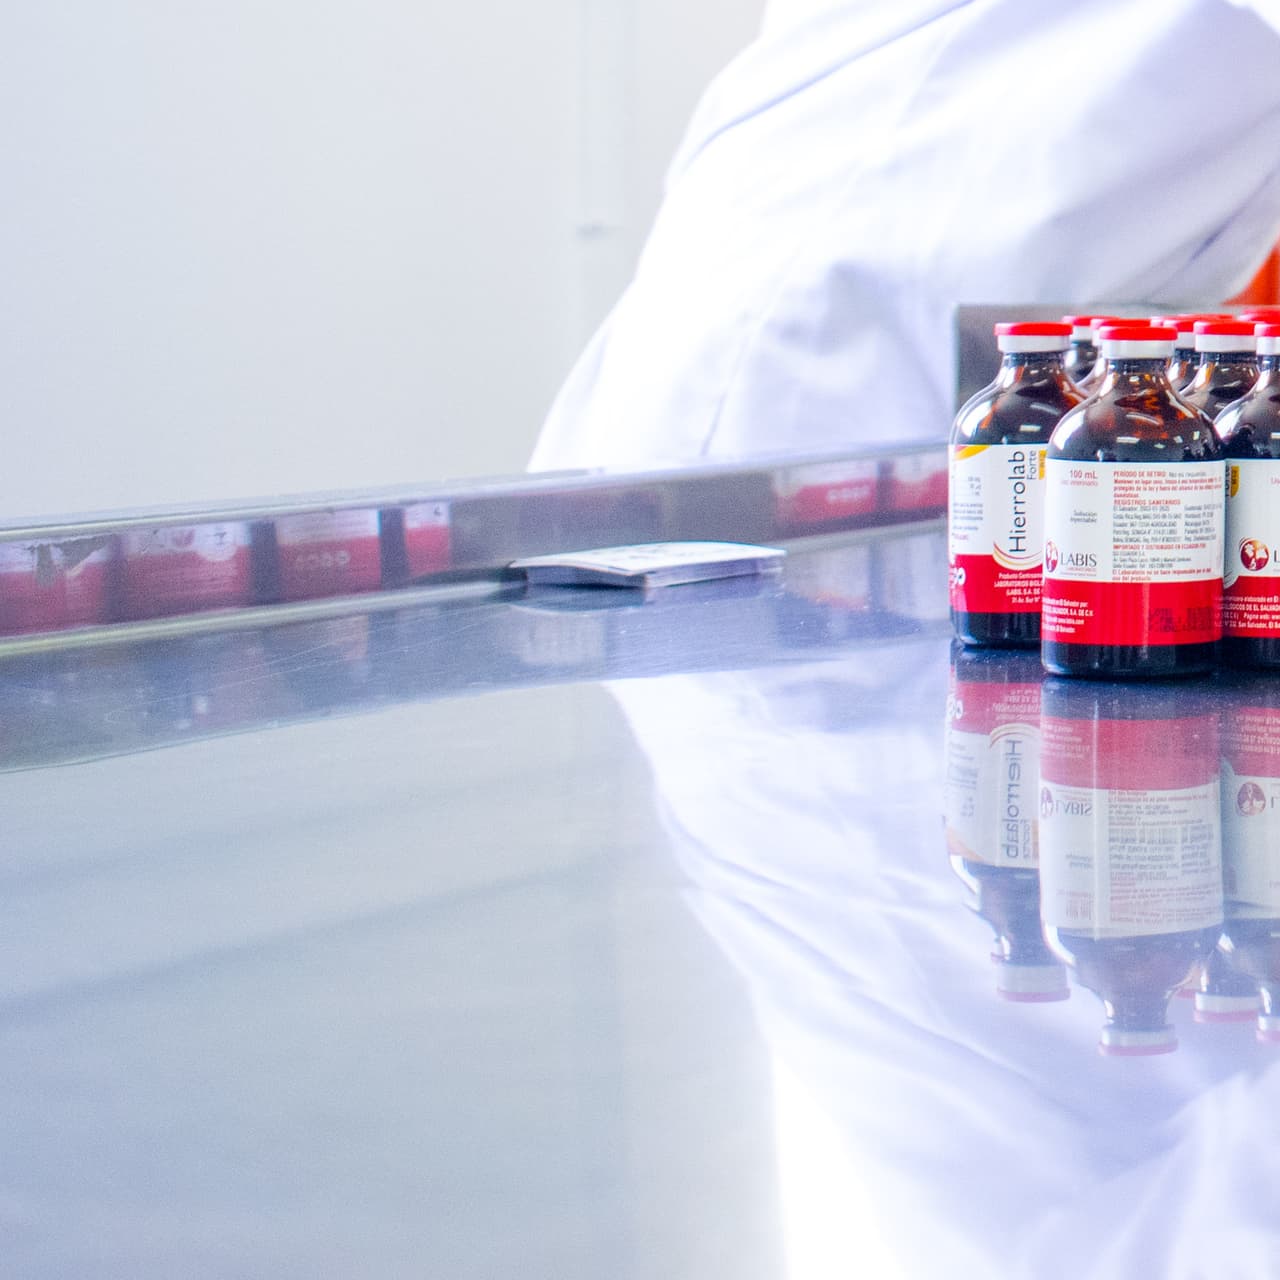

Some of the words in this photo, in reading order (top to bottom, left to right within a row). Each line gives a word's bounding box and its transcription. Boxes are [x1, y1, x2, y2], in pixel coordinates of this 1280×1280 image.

[1027, 450, 1036, 480] Forte
[1070, 470, 1082, 478] 100
[1084, 470, 1098, 478] mL
[1007, 450, 1026, 552] Hierrolab
[1060, 553, 1097, 567] LABIS
